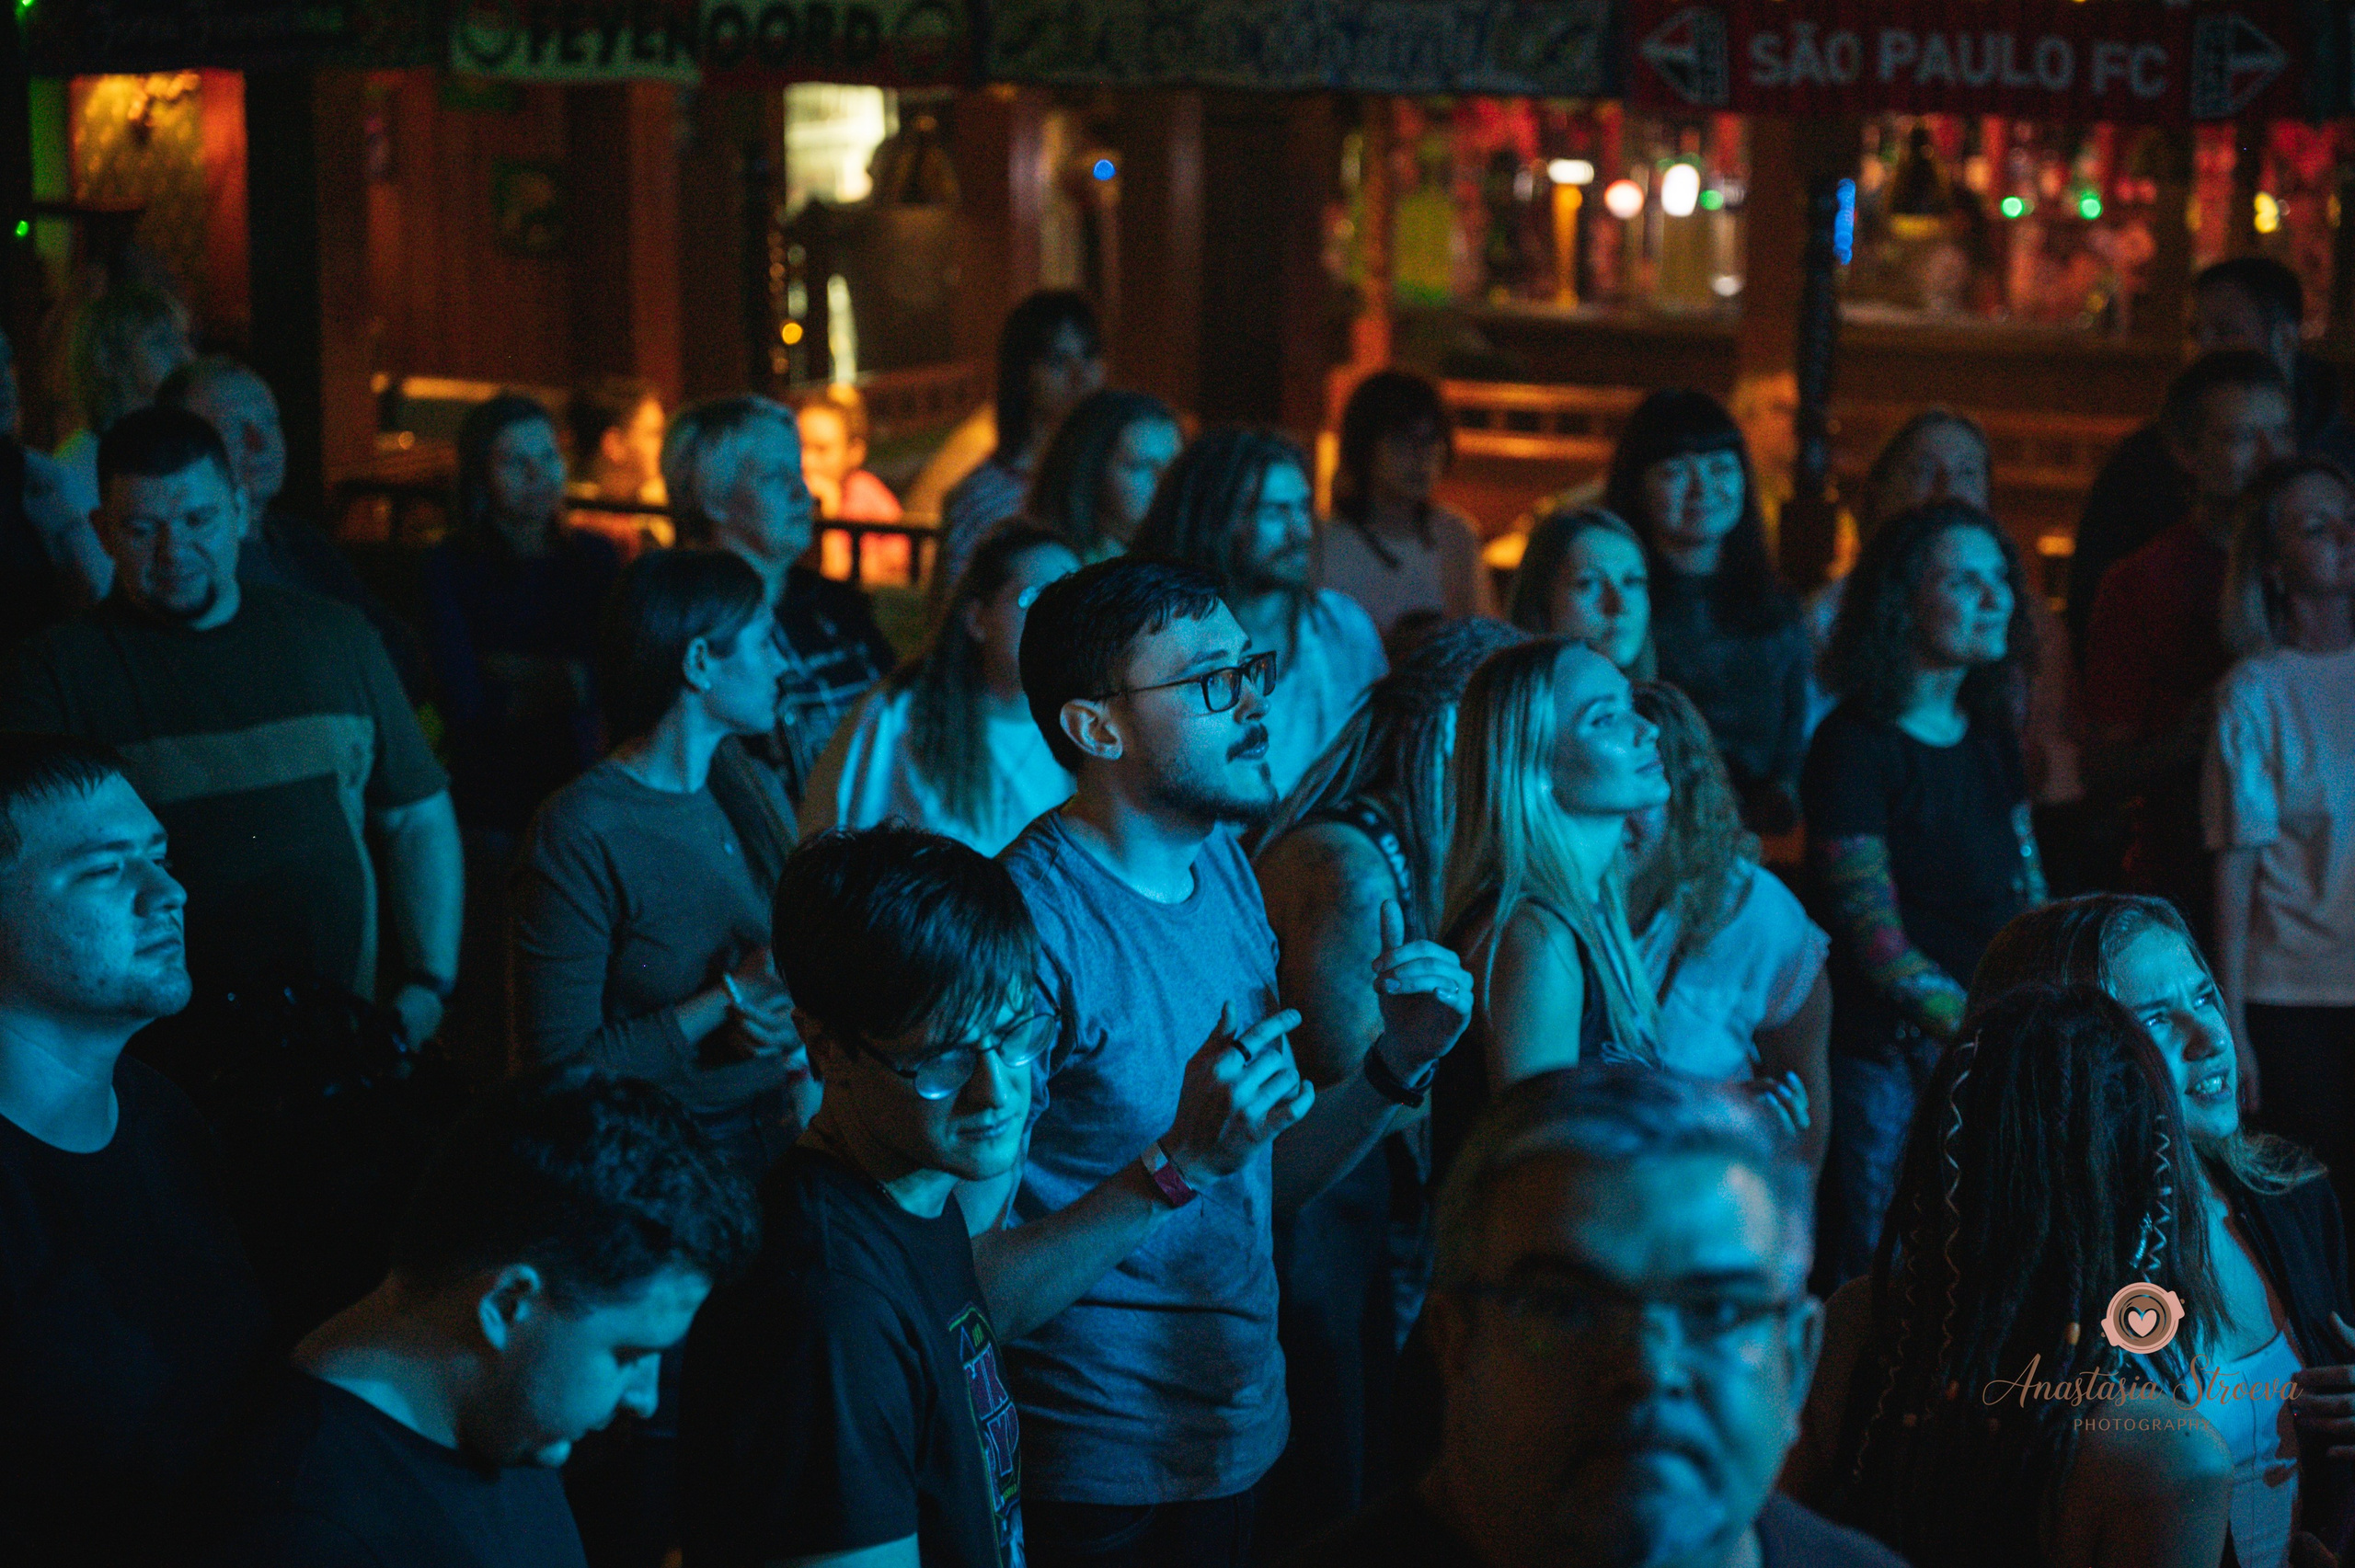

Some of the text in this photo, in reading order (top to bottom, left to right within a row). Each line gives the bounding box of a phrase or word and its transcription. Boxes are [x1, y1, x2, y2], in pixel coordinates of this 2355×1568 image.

[527, 1, 880, 70] FEYENOORD
[1748, 20, 2170, 97] SÃO PAULO FC
